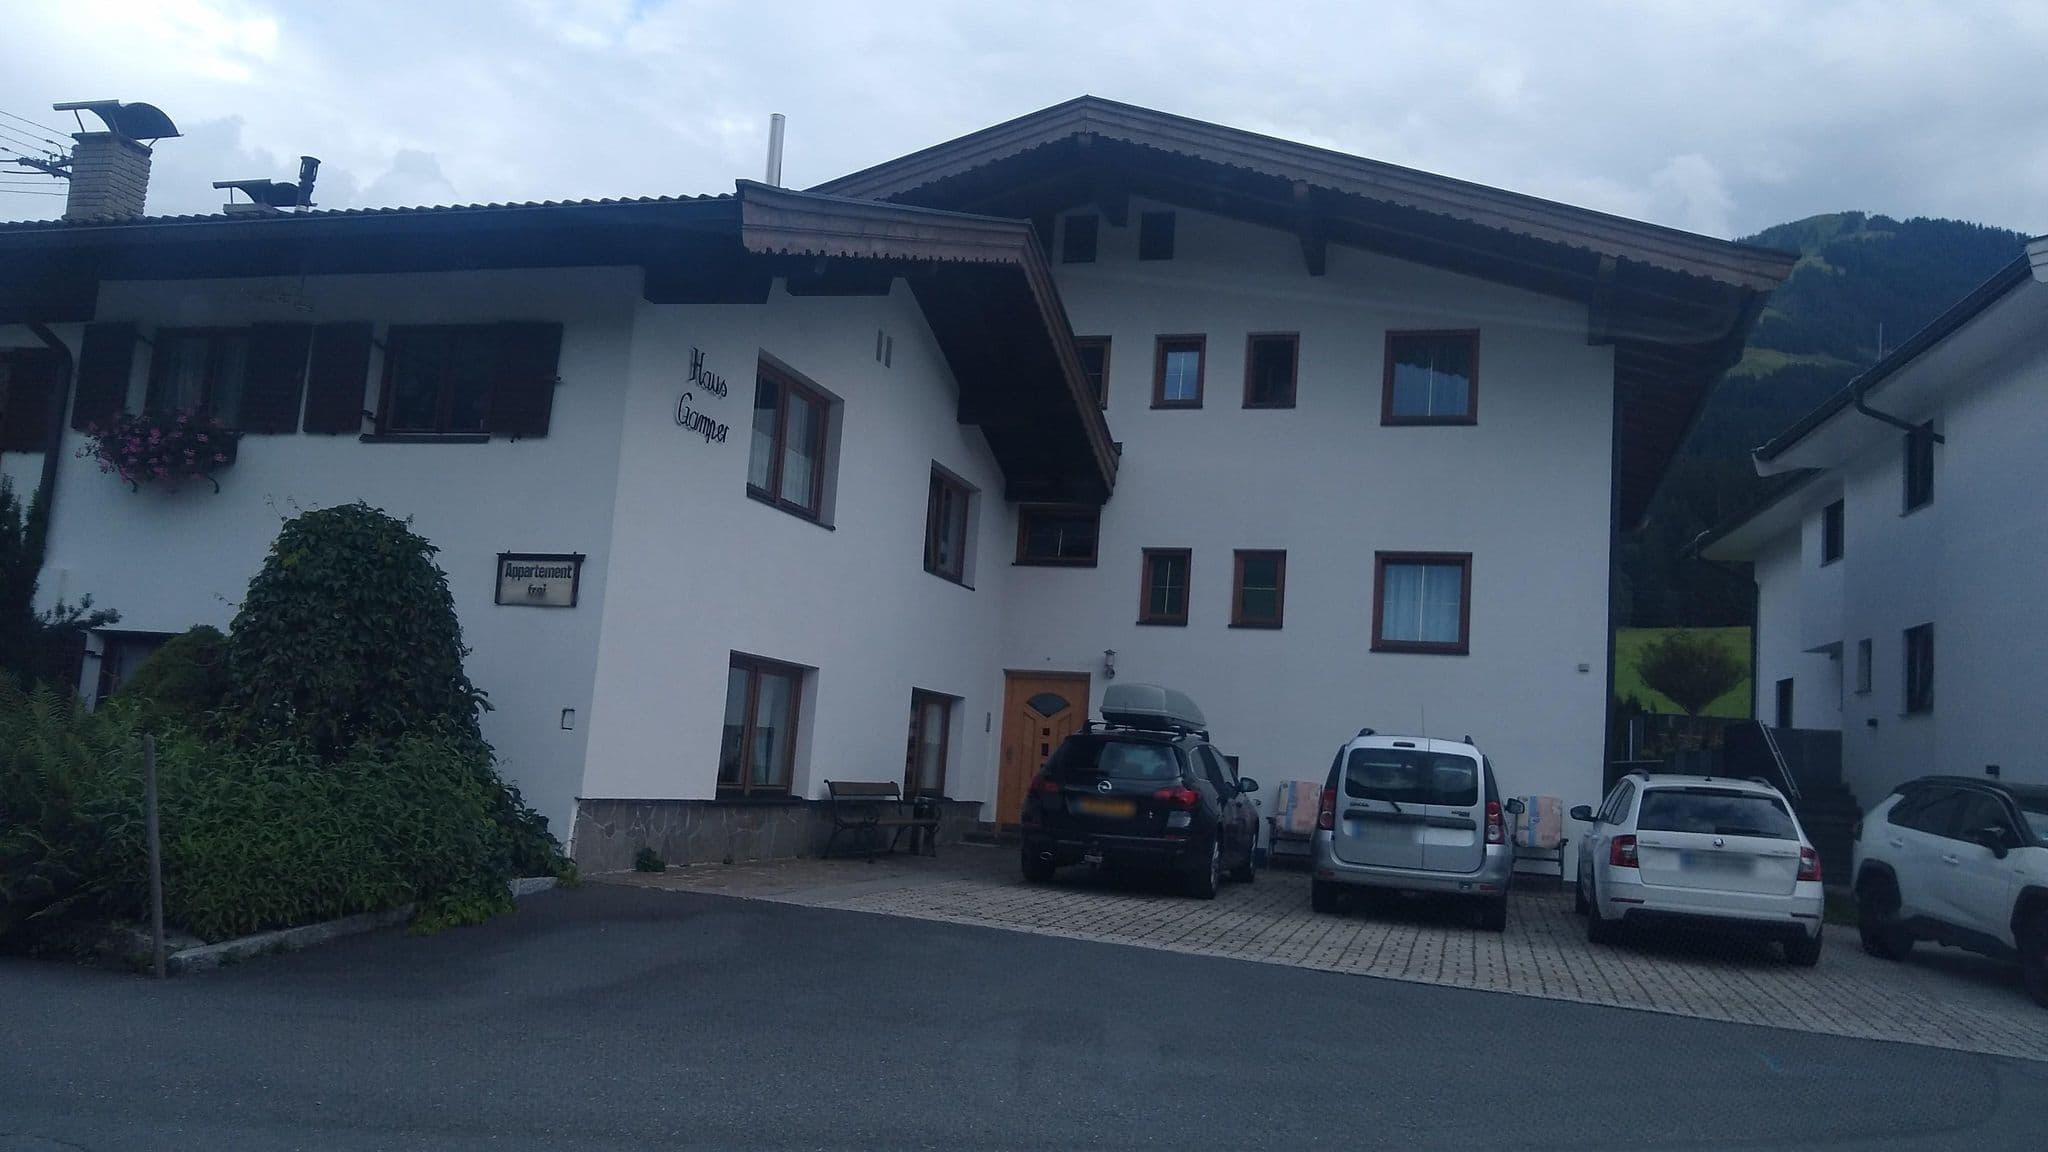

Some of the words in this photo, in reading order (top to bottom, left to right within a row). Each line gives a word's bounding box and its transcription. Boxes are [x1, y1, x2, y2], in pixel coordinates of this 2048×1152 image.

[689, 346, 728, 398] Haus
[677, 392, 730, 444] Gamper
[504, 562, 573, 581] Appartement
